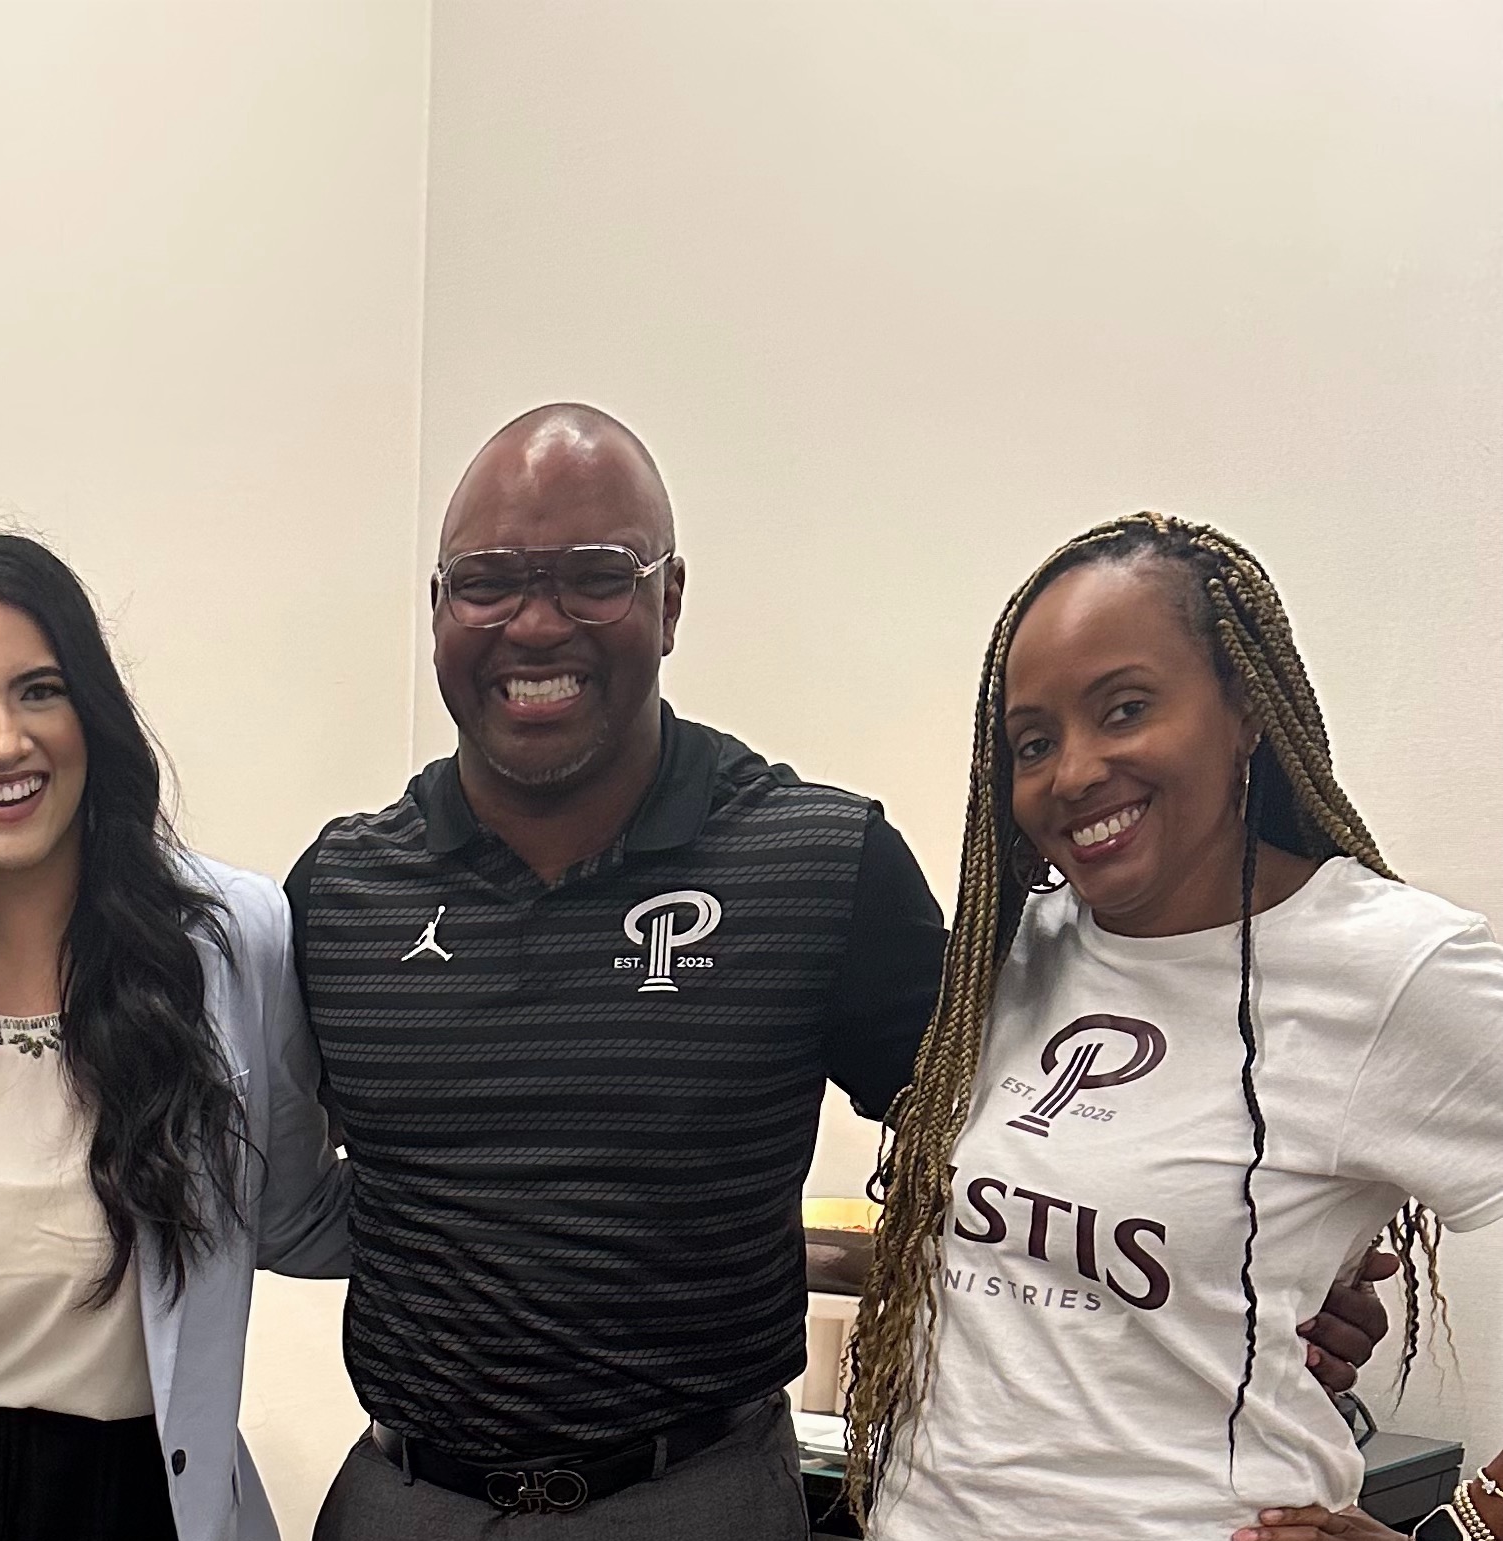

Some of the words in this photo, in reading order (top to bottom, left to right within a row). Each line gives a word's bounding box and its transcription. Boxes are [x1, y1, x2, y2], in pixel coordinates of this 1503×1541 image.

[613, 957, 645, 969] EST.
[676, 956, 714, 968] 2025
[1000, 1076, 1037, 1101] EST.
[1069, 1103, 1117, 1123] 2025
[937, 1164, 1171, 1311] STIS
[944, 1268, 1102, 1312] NISTRIES
